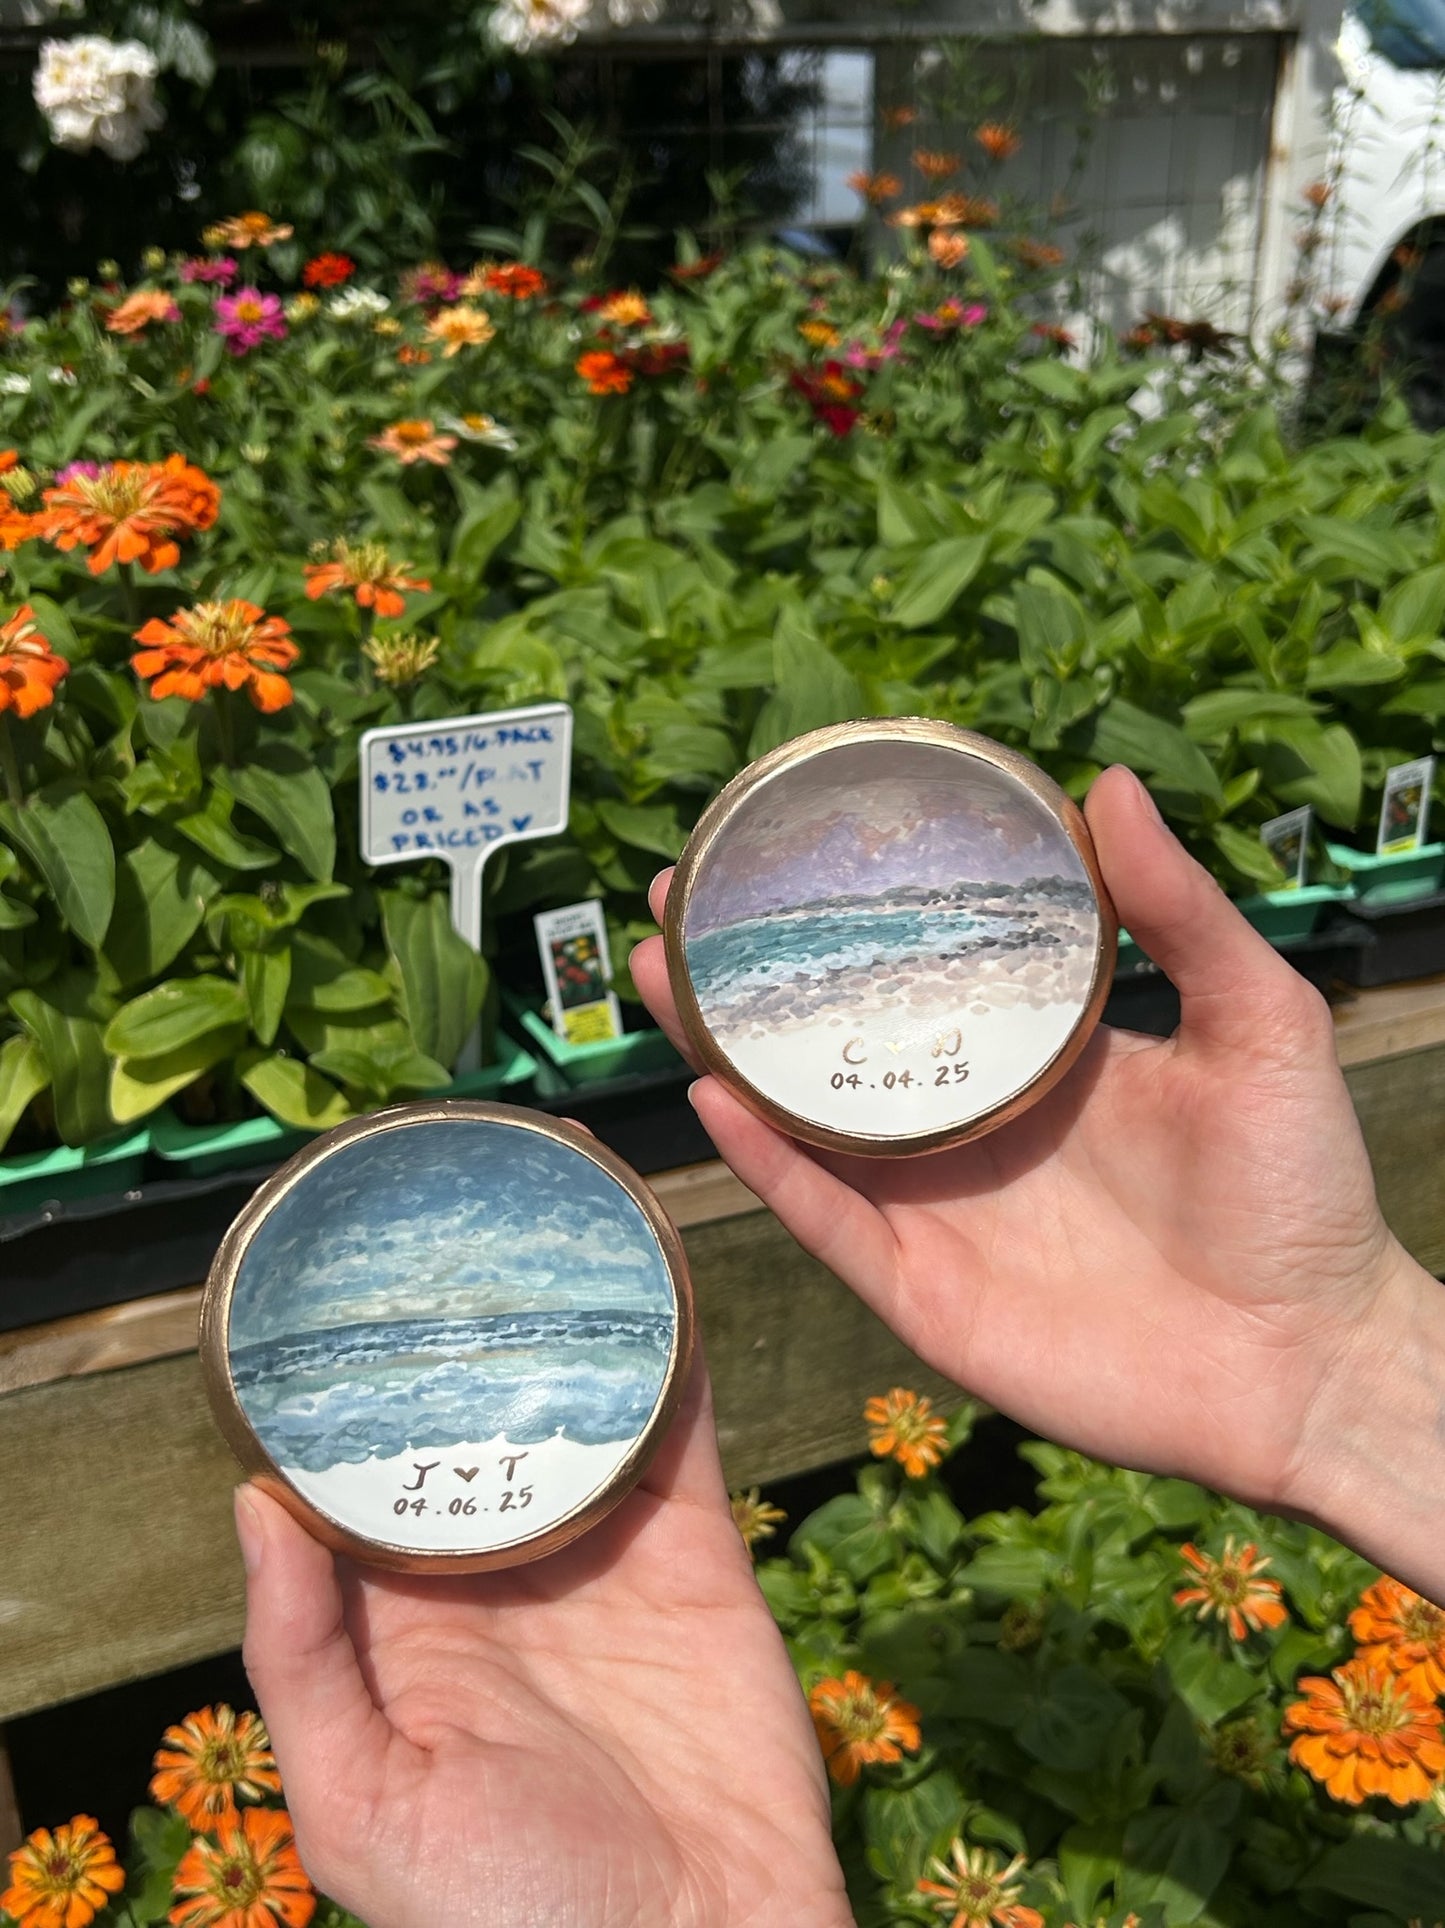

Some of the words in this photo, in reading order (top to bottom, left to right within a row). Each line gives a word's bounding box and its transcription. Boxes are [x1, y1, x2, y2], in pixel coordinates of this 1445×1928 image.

[402, 806, 443, 826] OR
[464, 799, 501, 818] AS
[391, 823, 504, 851] PRICED
[842, 1036, 868, 1066] C
[402, 1460, 441, 1491] J
[498, 1451, 529, 1482] T
